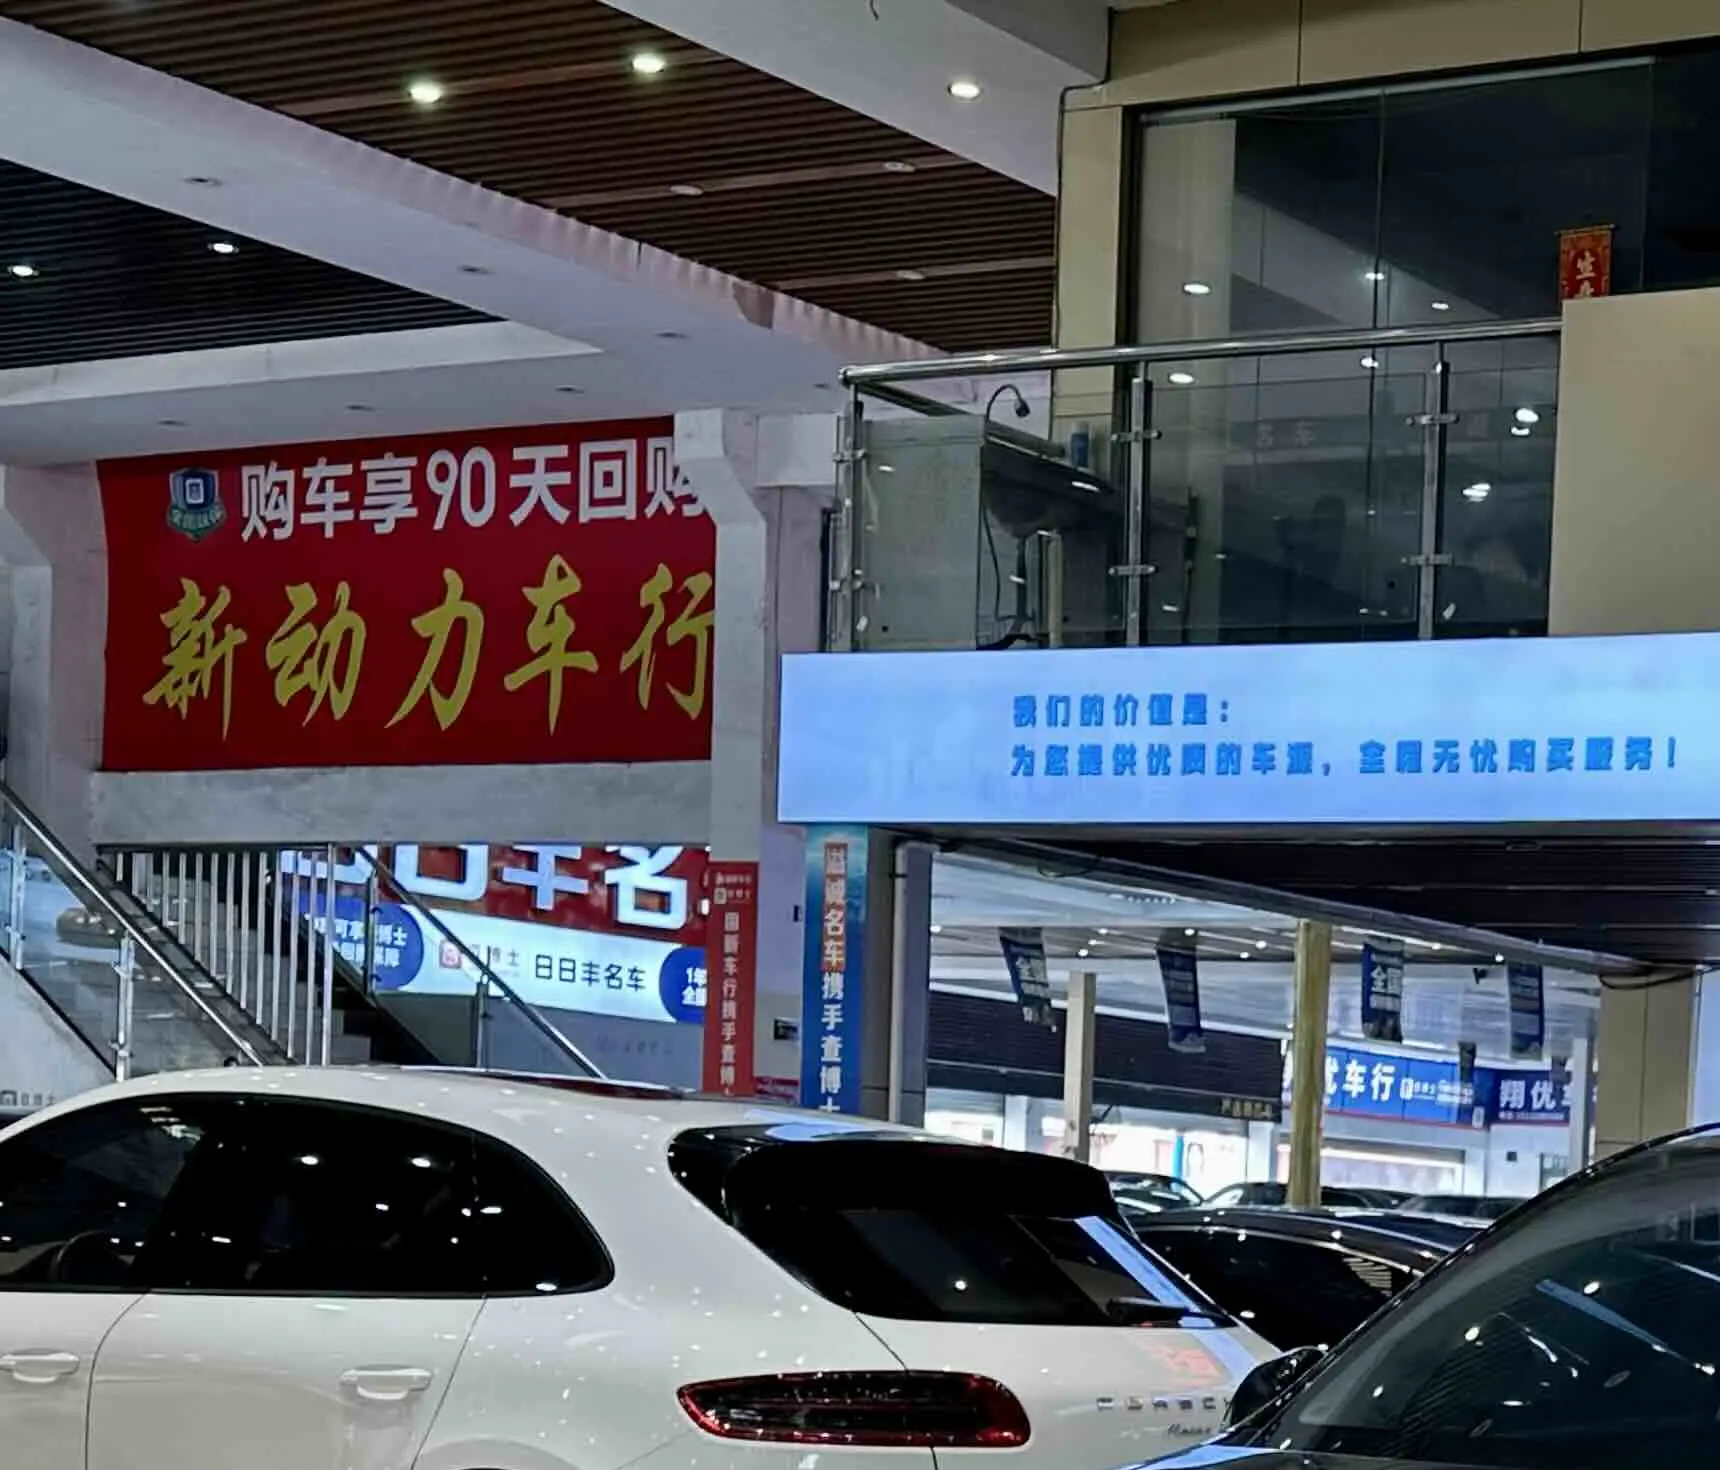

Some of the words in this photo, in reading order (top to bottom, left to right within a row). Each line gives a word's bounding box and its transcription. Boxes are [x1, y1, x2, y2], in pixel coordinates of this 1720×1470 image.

[142, 553, 713, 741] 新动力车行
[534, 953, 647, 993] 日日丰名车
